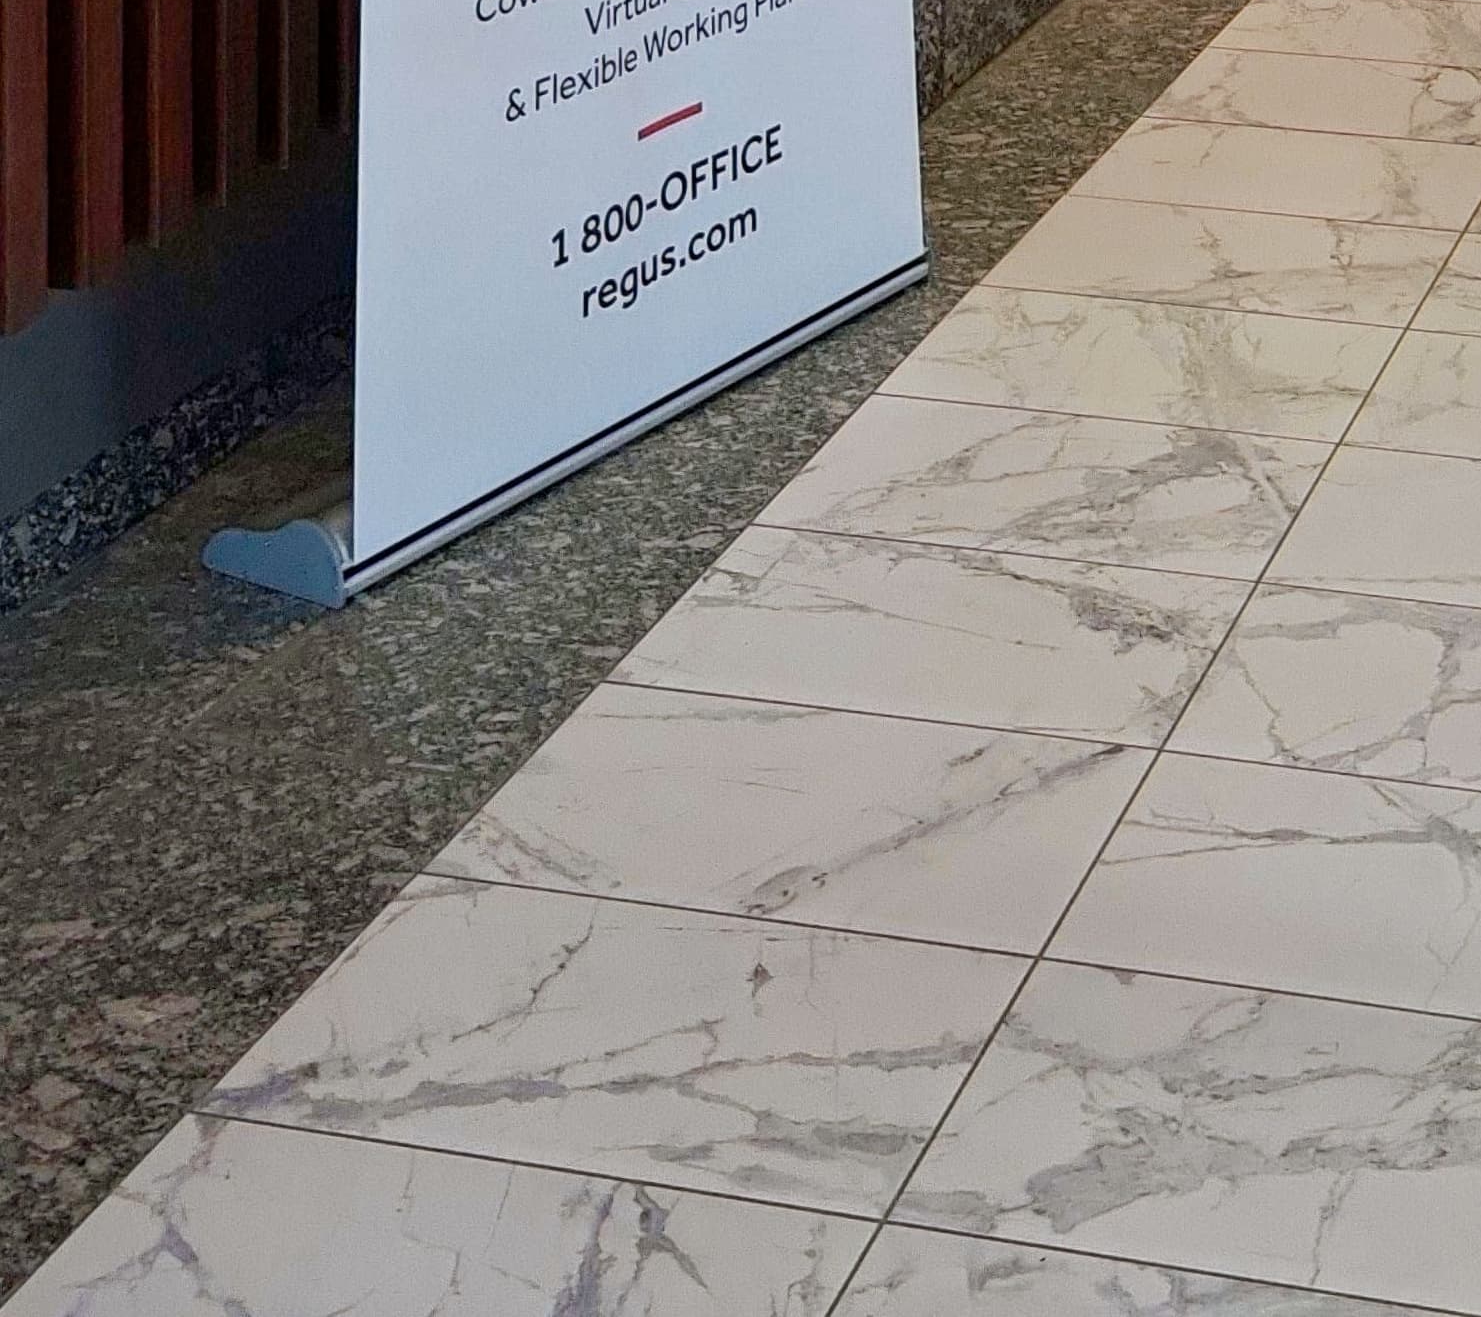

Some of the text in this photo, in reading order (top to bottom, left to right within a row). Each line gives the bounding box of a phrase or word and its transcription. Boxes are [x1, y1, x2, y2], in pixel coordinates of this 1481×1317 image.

[505, 87, 527, 122] &
[534, 44, 638, 112] Flexible
[550, 124, 783, 268] 1 800-OFFICE
[582, 206, 757, 318] regus.com
